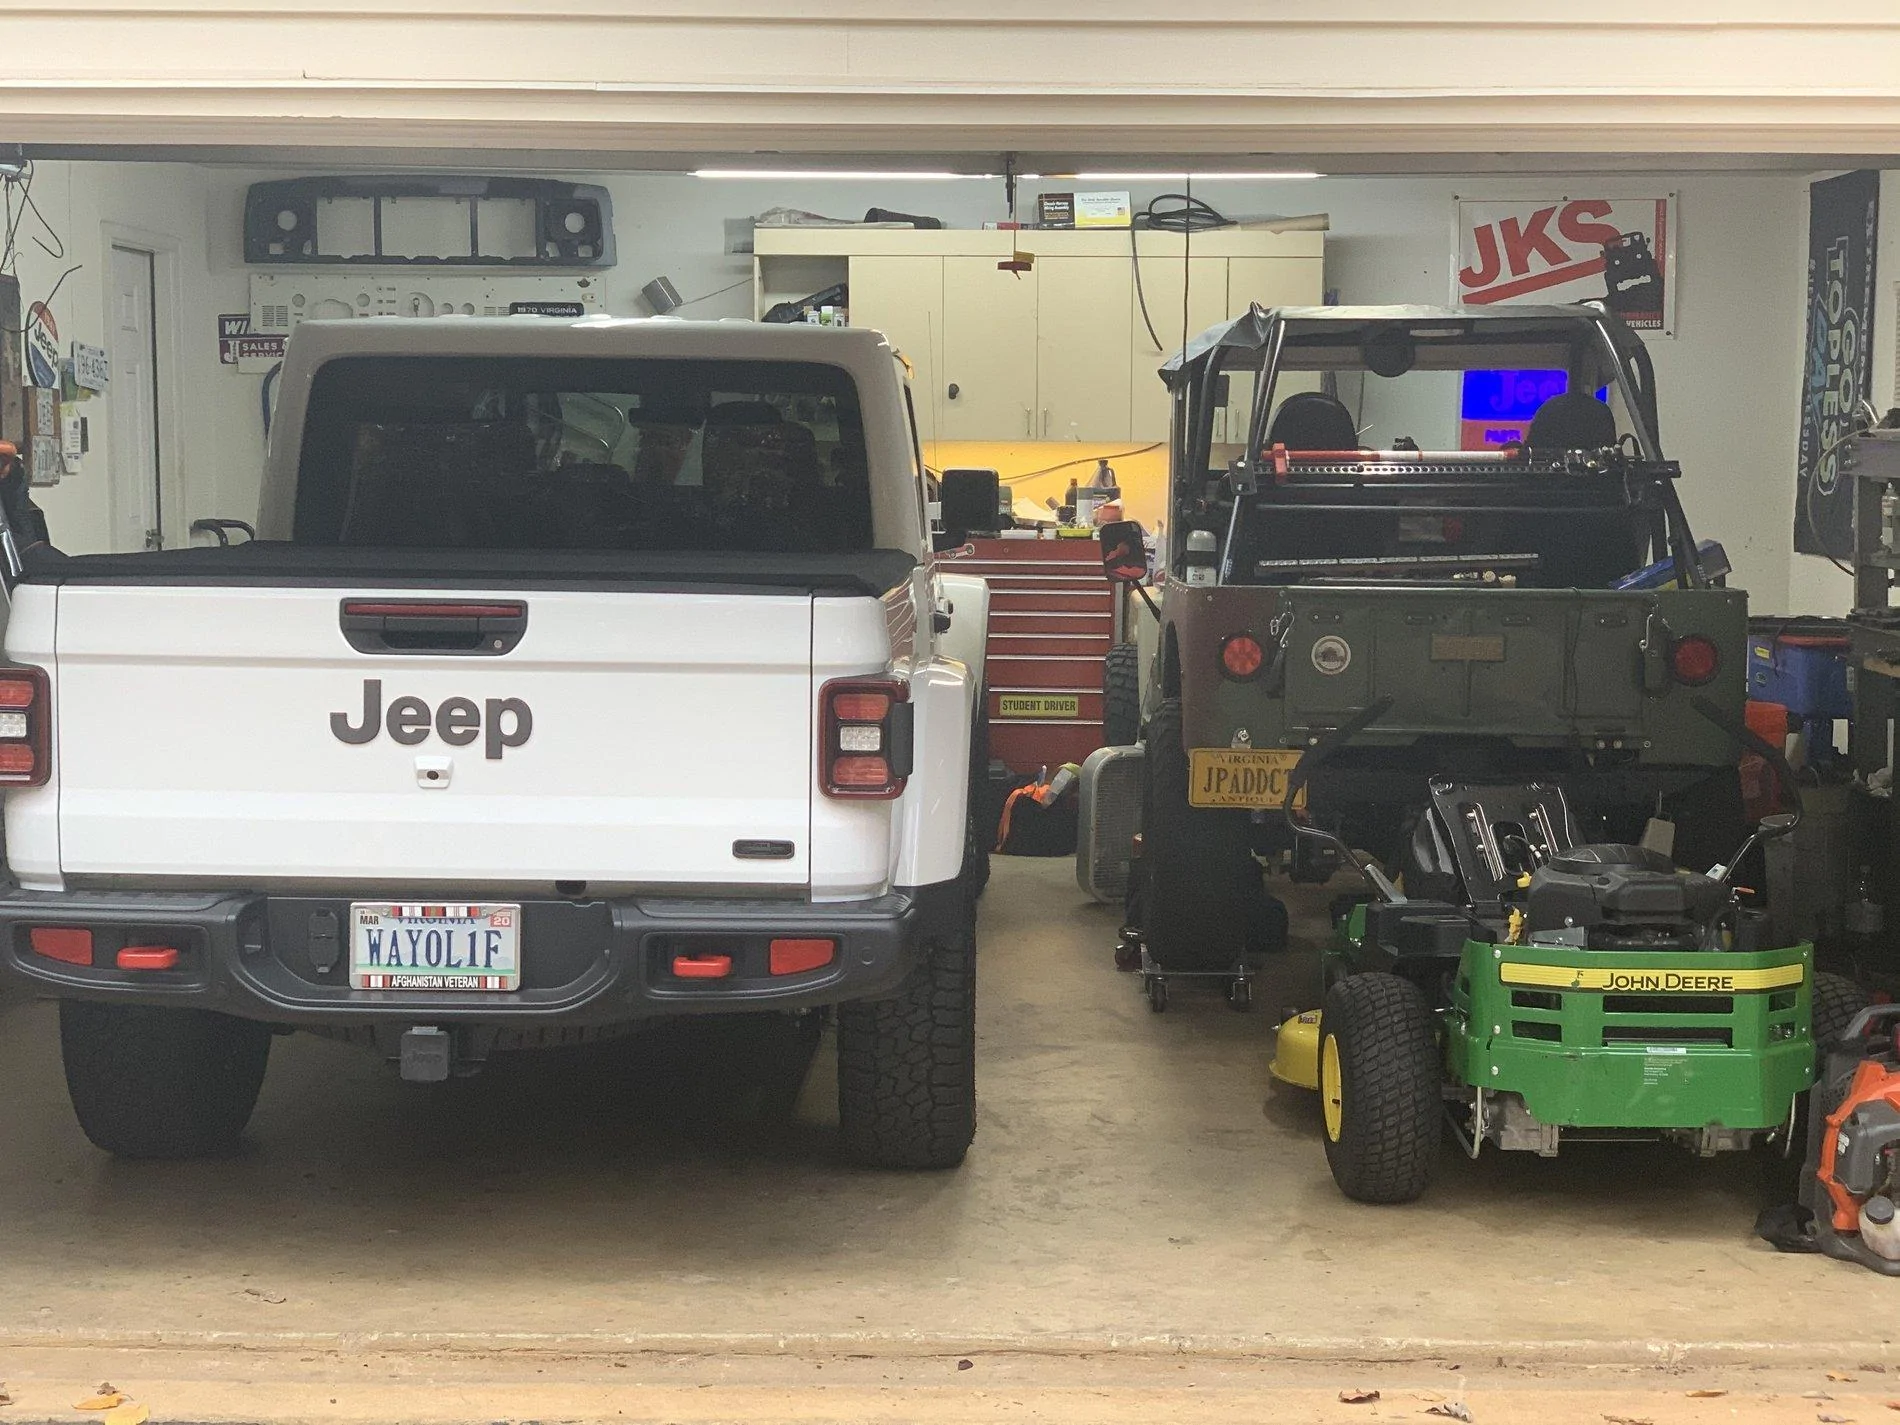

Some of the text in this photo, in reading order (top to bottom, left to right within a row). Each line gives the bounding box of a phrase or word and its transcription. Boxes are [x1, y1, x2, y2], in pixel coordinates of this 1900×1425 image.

[1459, 200, 1621, 288] JKS
[540, 306, 578, 314] VIRGINIA
[1626, 319, 1661, 328] VEHICLES
[33, 321, 59, 368] Jeep
[242, 342, 278, 351] SALES
[1819, 250, 1844, 484] TOPLESS
[1839, 319, 1857, 414] GO
[1489, 371, 1560, 412] Jee
[1002, 699, 1076, 711] STUDENT DRIVER
[330, 679, 533, 760] Jeep
[1220, 754, 1280, 765] VIRGINIA
[359, 915, 380, 925] MAR
[493, 917, 510, 926] 20
[366, 928, 502, 968] WAYOL1F
[391, 976, 479, 988] AFGHANISTAN VETERAN
[1602, 973, 1734, 989] JOHN DEERE
